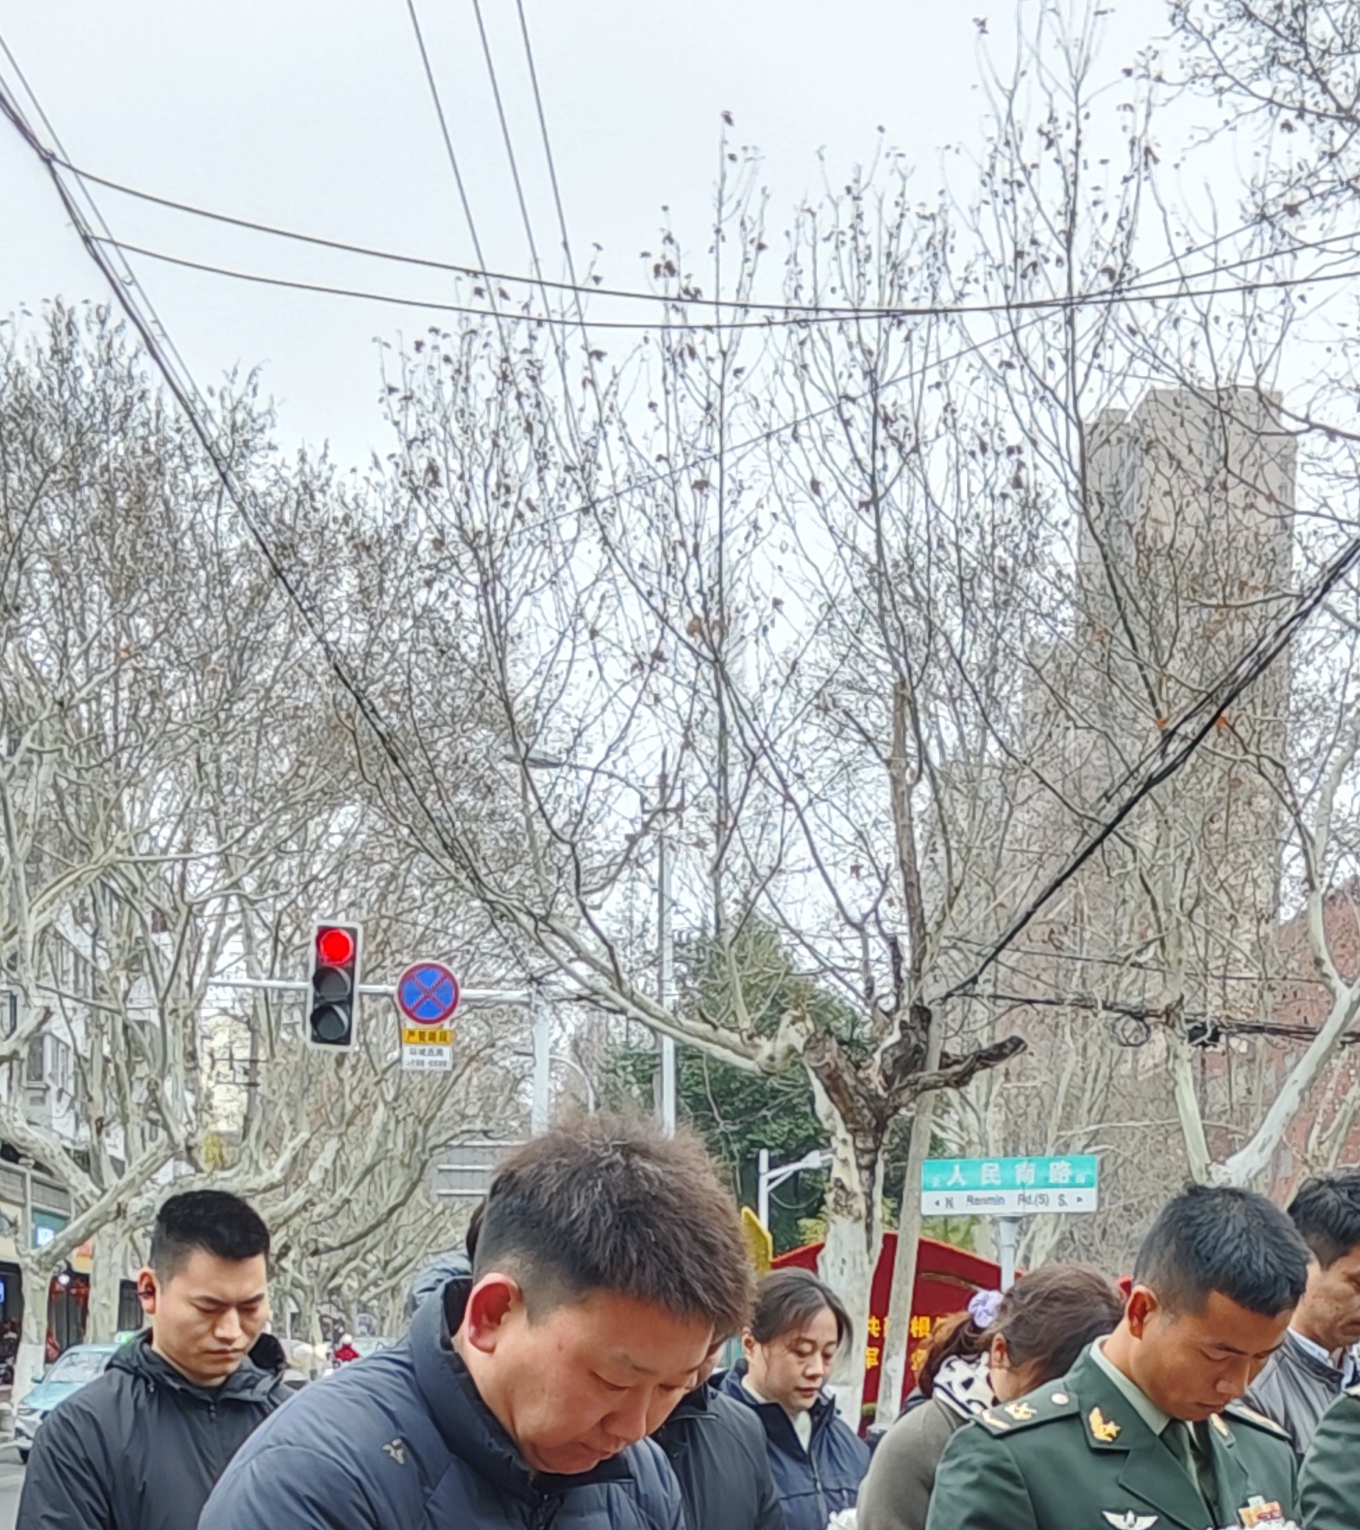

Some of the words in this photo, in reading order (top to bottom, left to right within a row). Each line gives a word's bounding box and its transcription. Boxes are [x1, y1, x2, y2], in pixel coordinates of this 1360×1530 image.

[946, 1160, 1073, 1188] 人民南路
[966, 1195, 1006, 1206] Renmin
